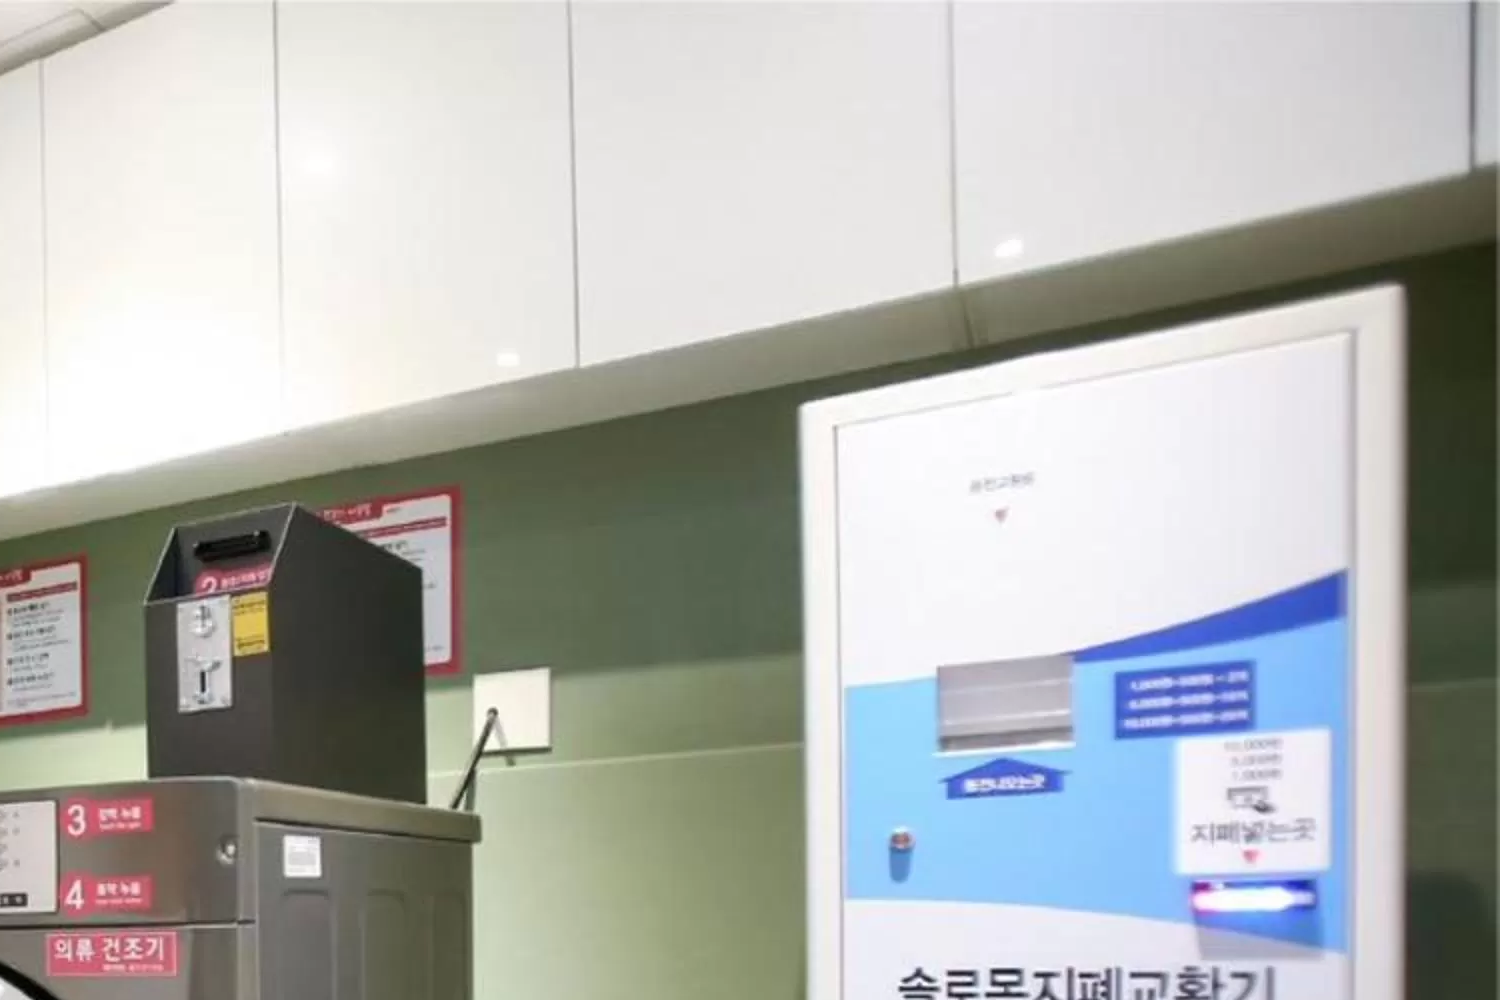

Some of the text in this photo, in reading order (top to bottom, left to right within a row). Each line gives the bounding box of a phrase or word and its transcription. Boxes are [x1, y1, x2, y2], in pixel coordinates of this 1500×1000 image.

[67, 804, 86, 836] 3
[64, 879, 85, 910] 4
[54, 936, 164, 962] 의류 건조기
